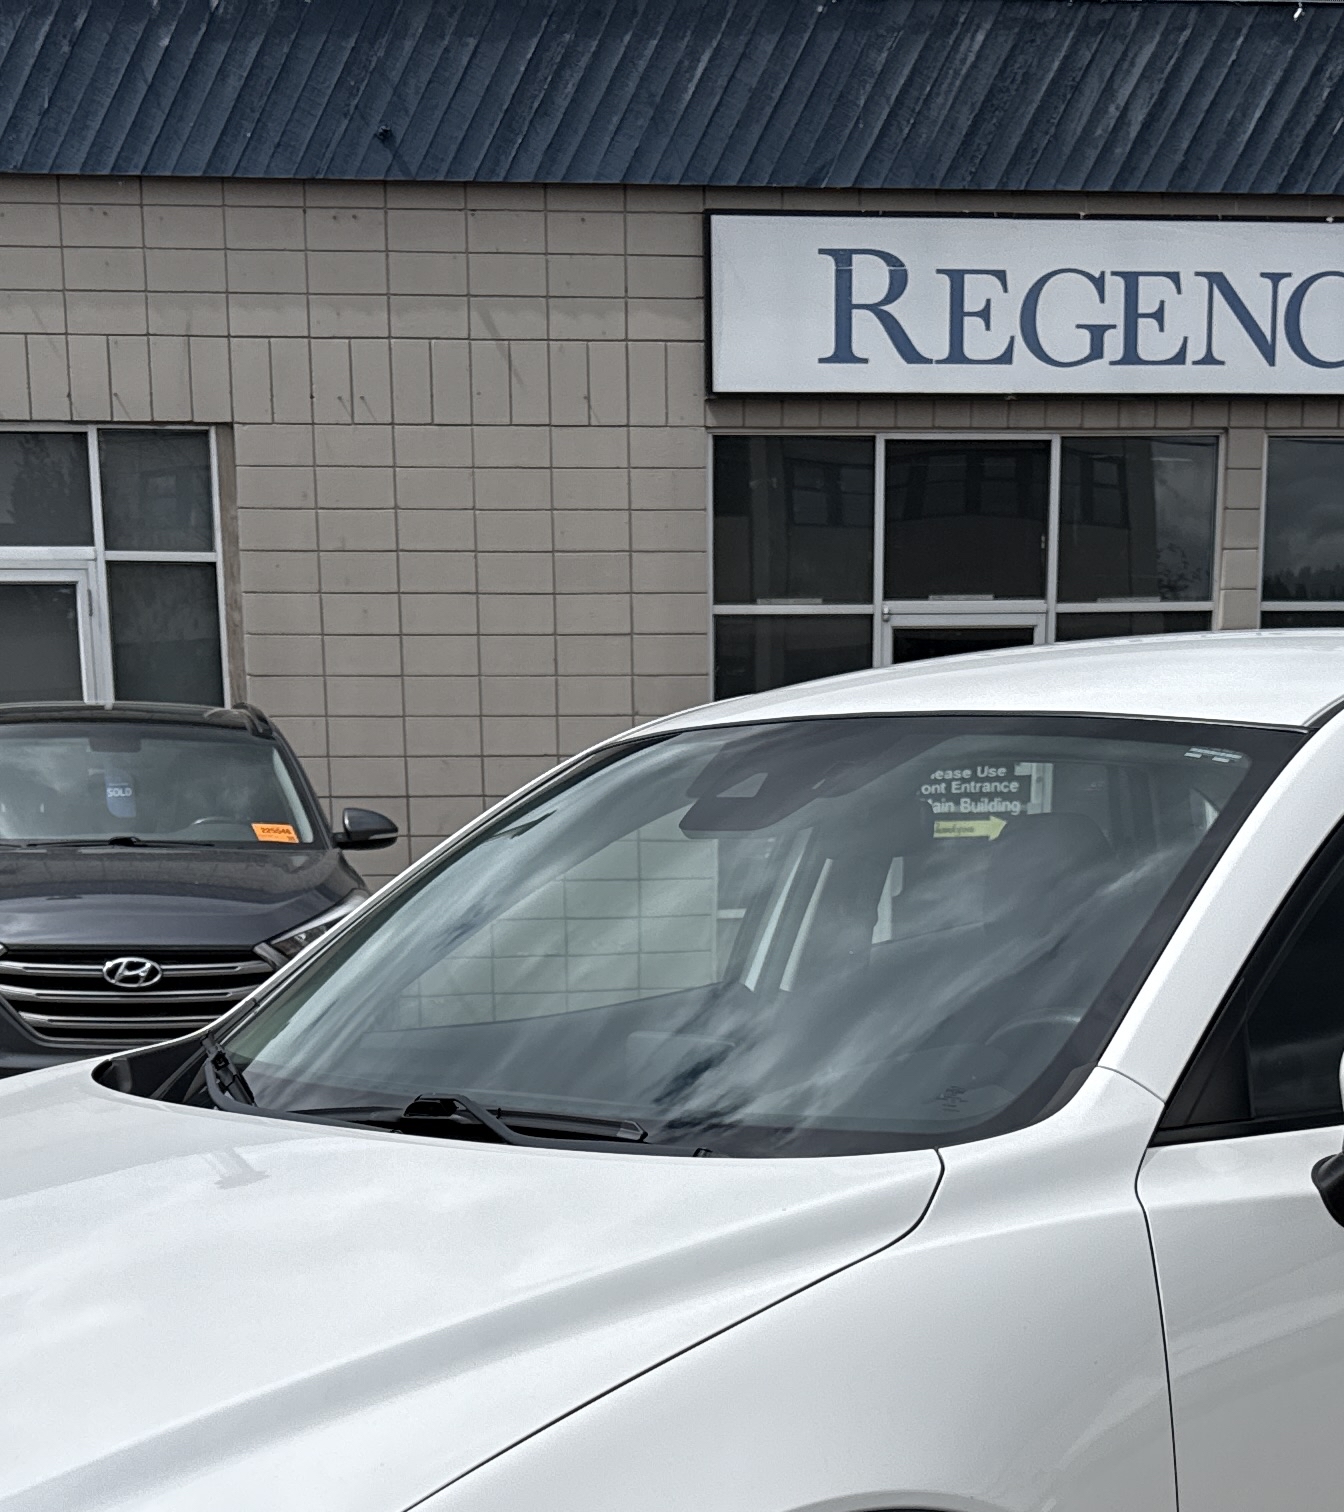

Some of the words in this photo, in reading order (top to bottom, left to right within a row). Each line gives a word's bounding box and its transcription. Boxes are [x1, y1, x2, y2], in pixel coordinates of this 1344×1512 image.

[930, 768, 972, 780] ease
[977, 766, 1007, 777] Use
[106, 787, 133, 798] SOLD
[921, 782, 946, 795] ont
[951, 780, 1020, 794] Entrance
[959, 797, 1021, 816] Building
